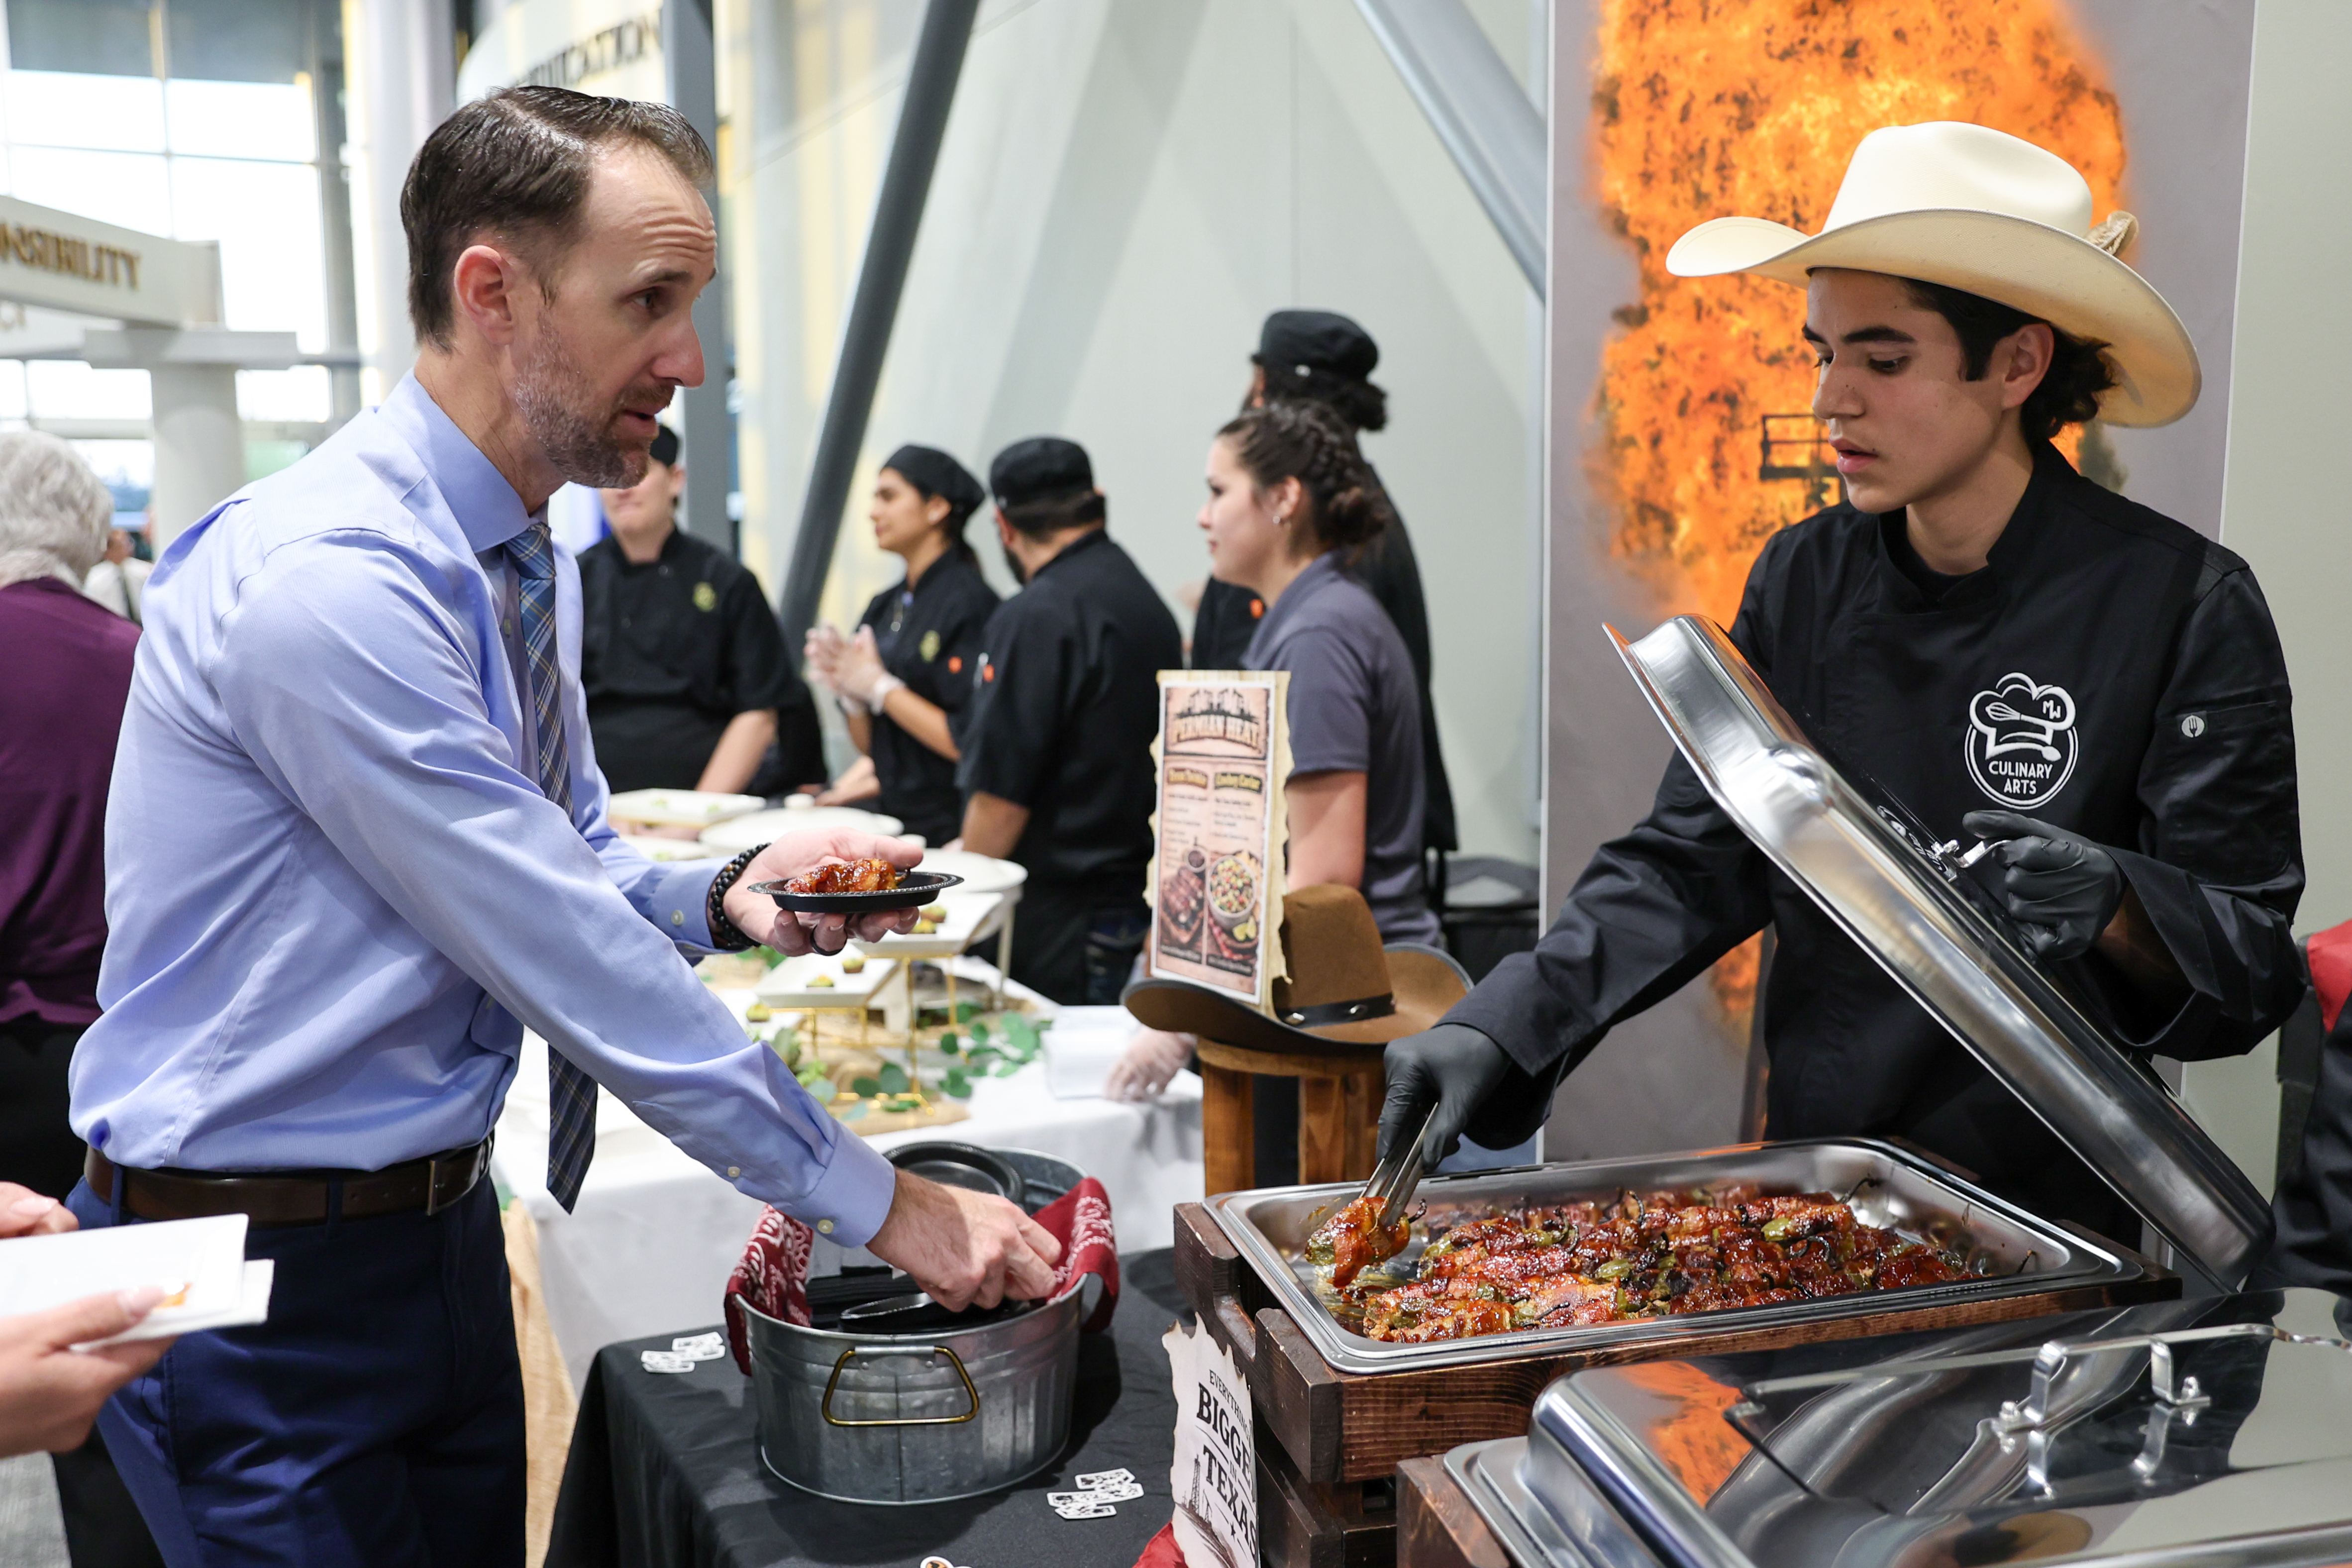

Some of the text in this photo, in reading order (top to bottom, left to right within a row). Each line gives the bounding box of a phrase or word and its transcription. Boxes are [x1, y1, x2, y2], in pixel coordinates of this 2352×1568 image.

[1226, 716, 1260, 749] HEAT
[1988, 760, 2053, 779] CULINARY
[2003, 778, 2037, 795] ARTS
[1229, 1460, 1237, 1483] IN
[1203, 1444, 1257, 1562] TEXAS
